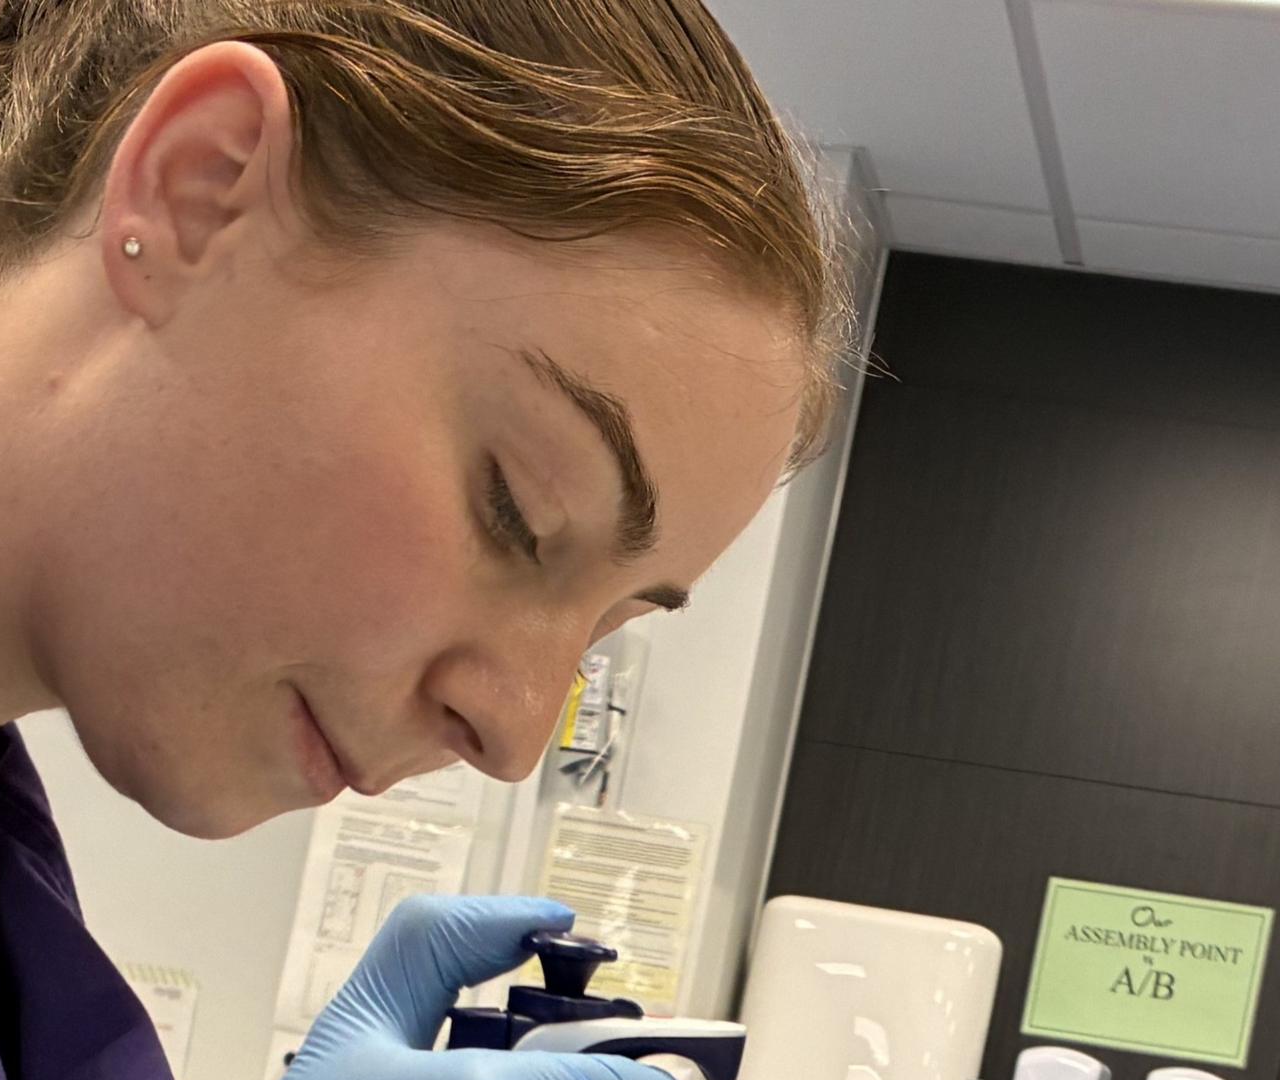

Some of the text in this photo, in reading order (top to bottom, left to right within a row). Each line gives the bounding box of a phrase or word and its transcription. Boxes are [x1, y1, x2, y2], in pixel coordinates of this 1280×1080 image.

[1064, 924, 1243, 965] ASSEMBLY POINT
[1110, 966, 1176, 1000] A/B
